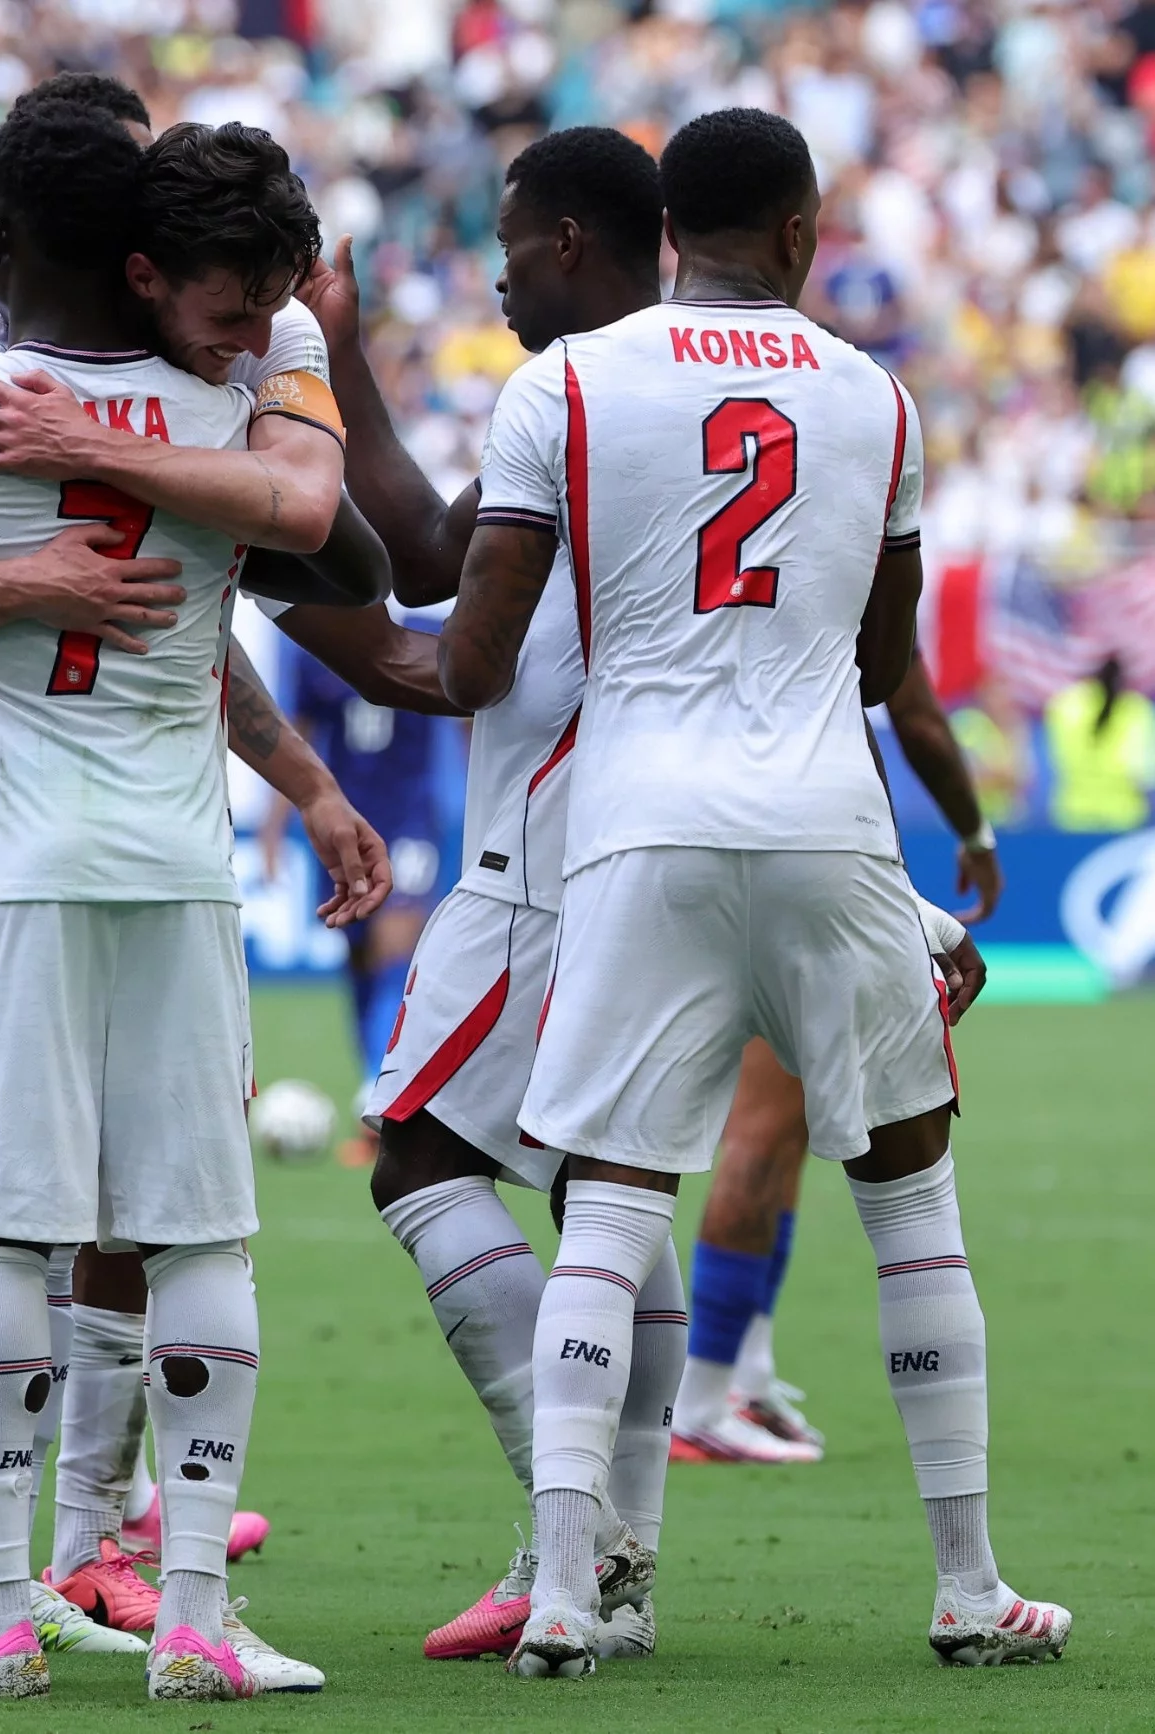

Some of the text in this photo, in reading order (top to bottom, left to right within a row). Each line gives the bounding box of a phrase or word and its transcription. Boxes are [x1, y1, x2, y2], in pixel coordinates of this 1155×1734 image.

[670, 327, 820, 371] KONSA
[82, 397, 171, 445] KA
[693, 397, 798, 615] 2
[45, 478, 156, 696] 7
[560, 1338, 612, 1369] ENG
[890, 1350, 940, 1374] ENG
[188, 1438, 235, 1463] ENG
